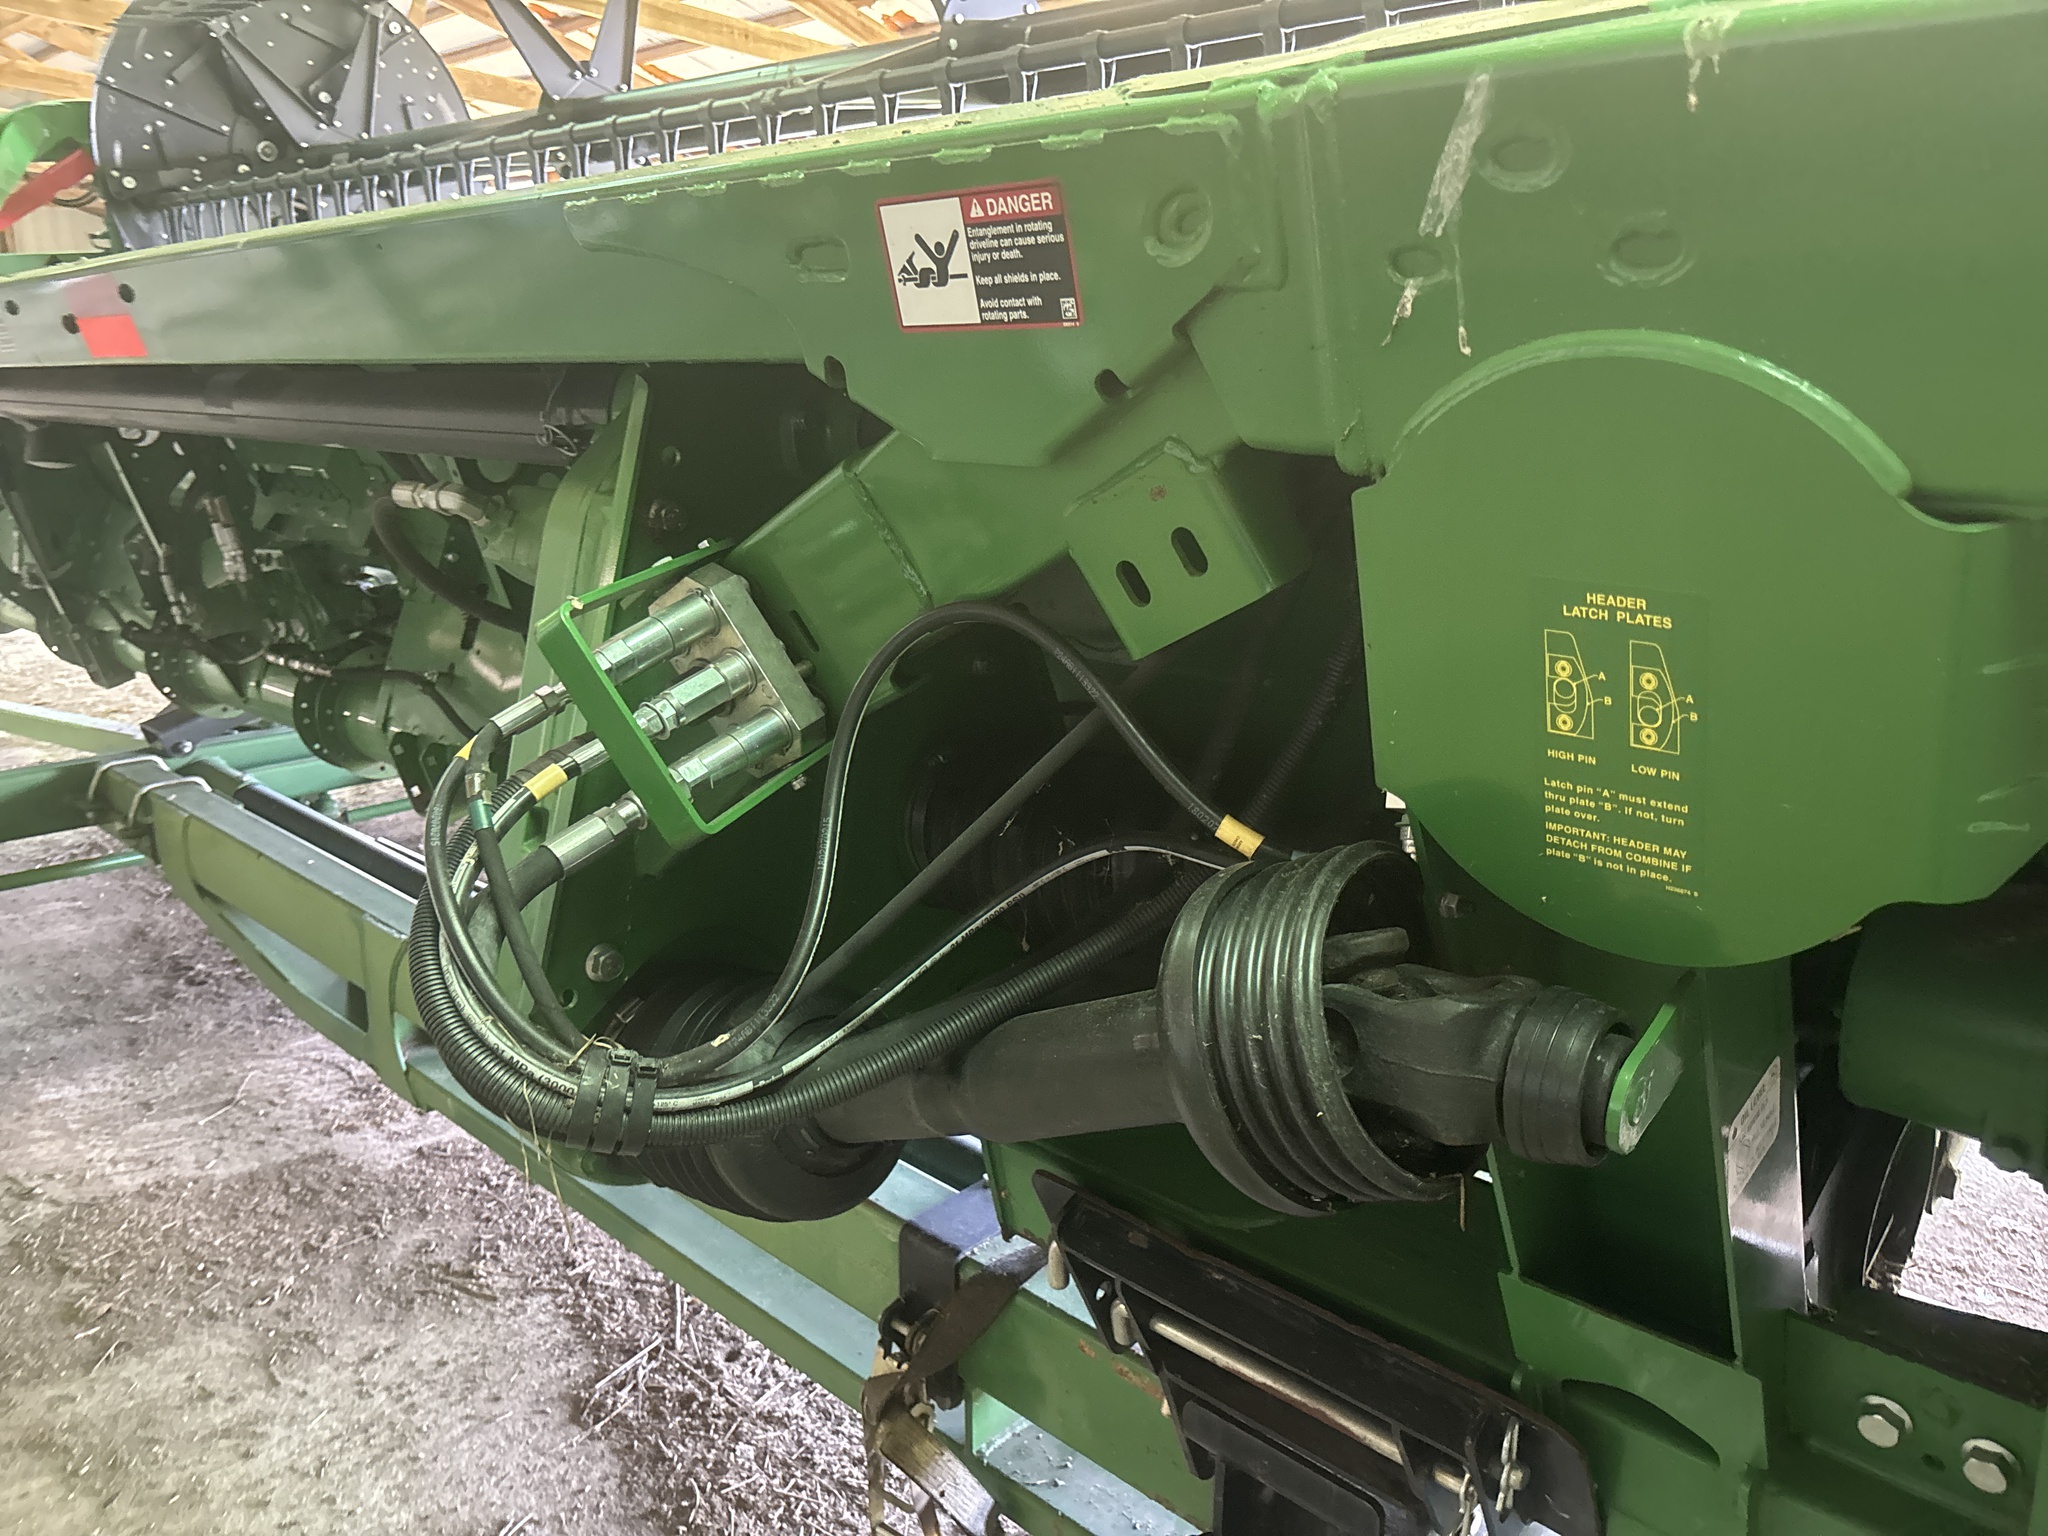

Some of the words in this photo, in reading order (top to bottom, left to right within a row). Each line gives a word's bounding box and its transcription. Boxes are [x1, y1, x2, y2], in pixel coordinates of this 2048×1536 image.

[986, 192, 1053, 216] DANGER
[967, 225, 1014, 238] Entanglement
[1015, 224, 1022, 232] in
[1024, 221, 1053, 232] rotating
[969, 239, 999, 250] driveline
[1000, 238, 1013, 247] can
[1014, 236, 1035, 246] cause
[1037, 233, 1064, 243] serious
[972, 251, 991, 263] injury
[993, 252, 1000, 260] or
[1001, 249, 1023, 259] death.
[976, 275, 994, 287] Keep
[995, 274, 1003, 284] all
[1004, 272, 1029, 283] shields
[1030, 271, 1037, 281] in
[1039, 272, 1061, 283] place.
[980, 298, 999, 308] Avoid
[1000, 297, 1026, 307] contact
[1027, 296, 1042, 306] with
[982, 309, 1008, 322] rotating
[1009, 308, 1029, 320] parts.
[1586, 592, 1647, 610] HEADER
[1563, 605, 1609, 621] LATCH
[1616, 611, 1673, 629] PLATES
[1598, 672, 1606, 681] A
[1604, 697, 1612, 706] B
[1686, 695, 1694, 704] A
[1690, 712, 1698, 721] B
[1547, 749, 1574, 762] HIGH
[1578, 754, 1596, 765] PIN
[1631, 764, 1656, 776] LOW
[1661, 769, 1680, 781] PIN
[1544, 777, 1573, 791] Latch
[1576, 783, 1594, 795] pin
[1619, 793, 1646, 805] must
[1650, 799, 1689, 814] extend
[1544, 791, 1566, 802] thru
[1569, 795, 1596, 808] plate
[1625, 806, 1633, 815] If
[1636, 810, 1657, 822] not,
[1661, 814, 1685, 826] turn
[1545, 804, 1571, 817] plate
[1574, 811, 1600, 822] over.
[1545, 822, 1610, 843] IMPORTANT:
[1613, 836, 1660, 853] HEADER
[1663, 847, 1687, 860] MAY
[1546, 834, 1588, 850] DETACH
[1591, 844, 1622, 858] FROM
[1625, 852, 1678, 870] COMBINE
[1681, 864, 1692, 874] IF
[1546, 847, 1571, 860] plate
[1594, 858, 1603, 867] is
[1606, 860, 1624, 872] not
[1627, 865, 1636, 875] in
[1640, 868, 1673, 883] place.
